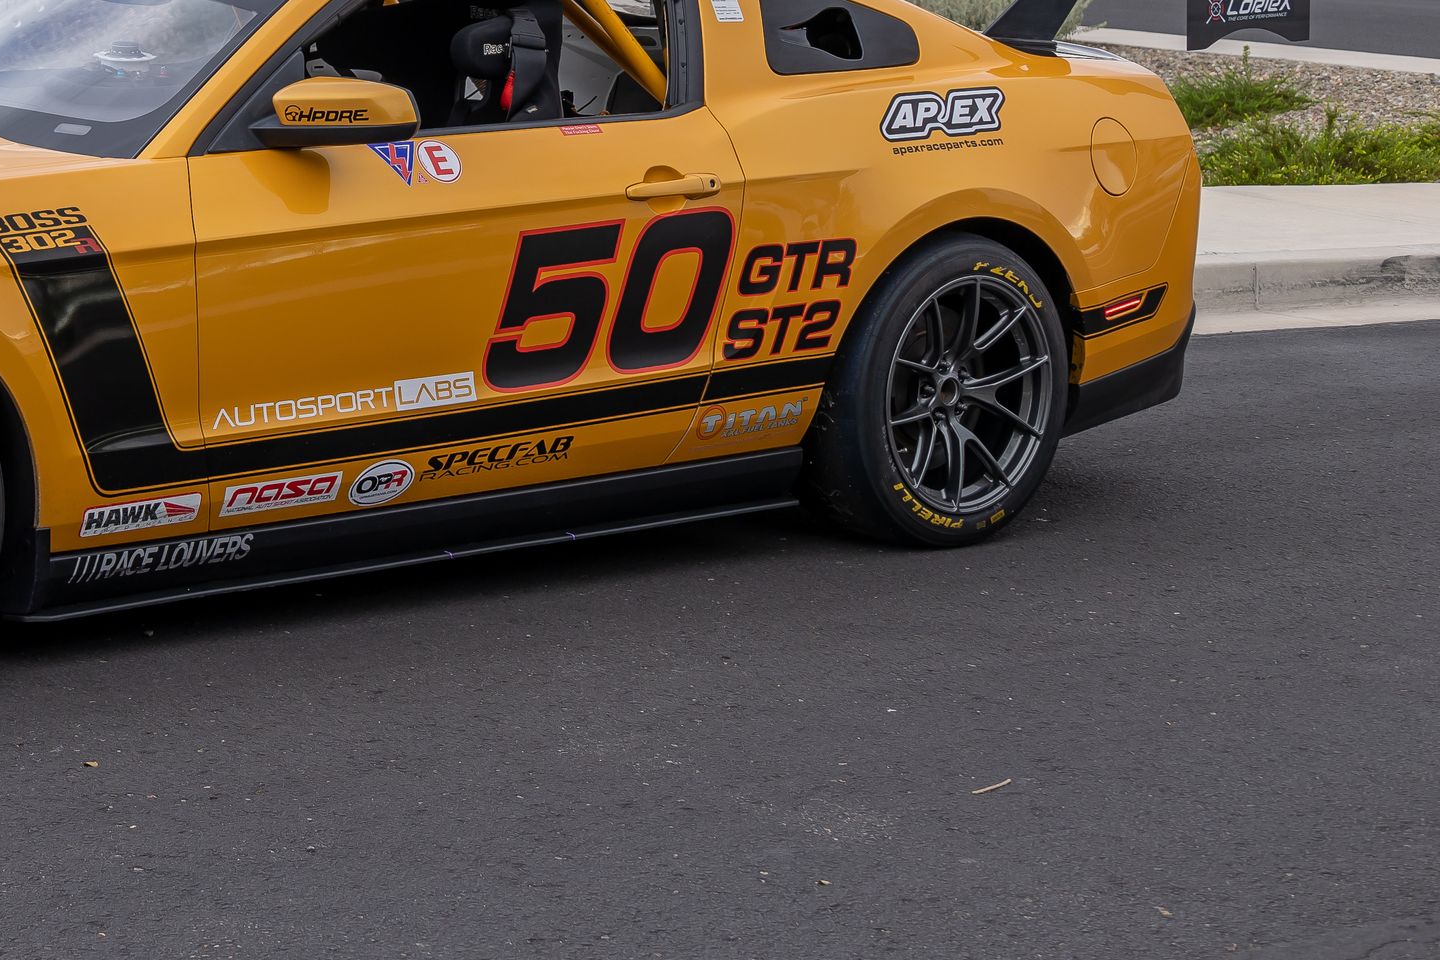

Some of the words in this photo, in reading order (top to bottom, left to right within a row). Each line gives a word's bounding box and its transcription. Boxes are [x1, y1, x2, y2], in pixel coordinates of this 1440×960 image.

[891, 96, 994, 129] APEX
[424, 145, 454, 176] E
[892, 138, 1004, 156] apexraceparts.com
[737, 237, 857, 297] GTR
[482, 206, 736, 393] 50
[722, 299, 842, 362] ST2
[212, 386, 394, 431] AUTOSPORT
[398, 377, 474, 406] LABS
[700, 400, 803, 434] TITAN
[418, 451, 569, 482] RACING.COM
[422, 435, 575, 475] SPECFAB
[226, 476, 339, 508] nasa
[356, 469, 409, 494] OPR
[84, 501, 164, 530] HAWK
[893, 482, 964, 528] PIRELLI
[95, 546, 159, 580] RACE
[154, 533, 254, 572] LOUVERS
